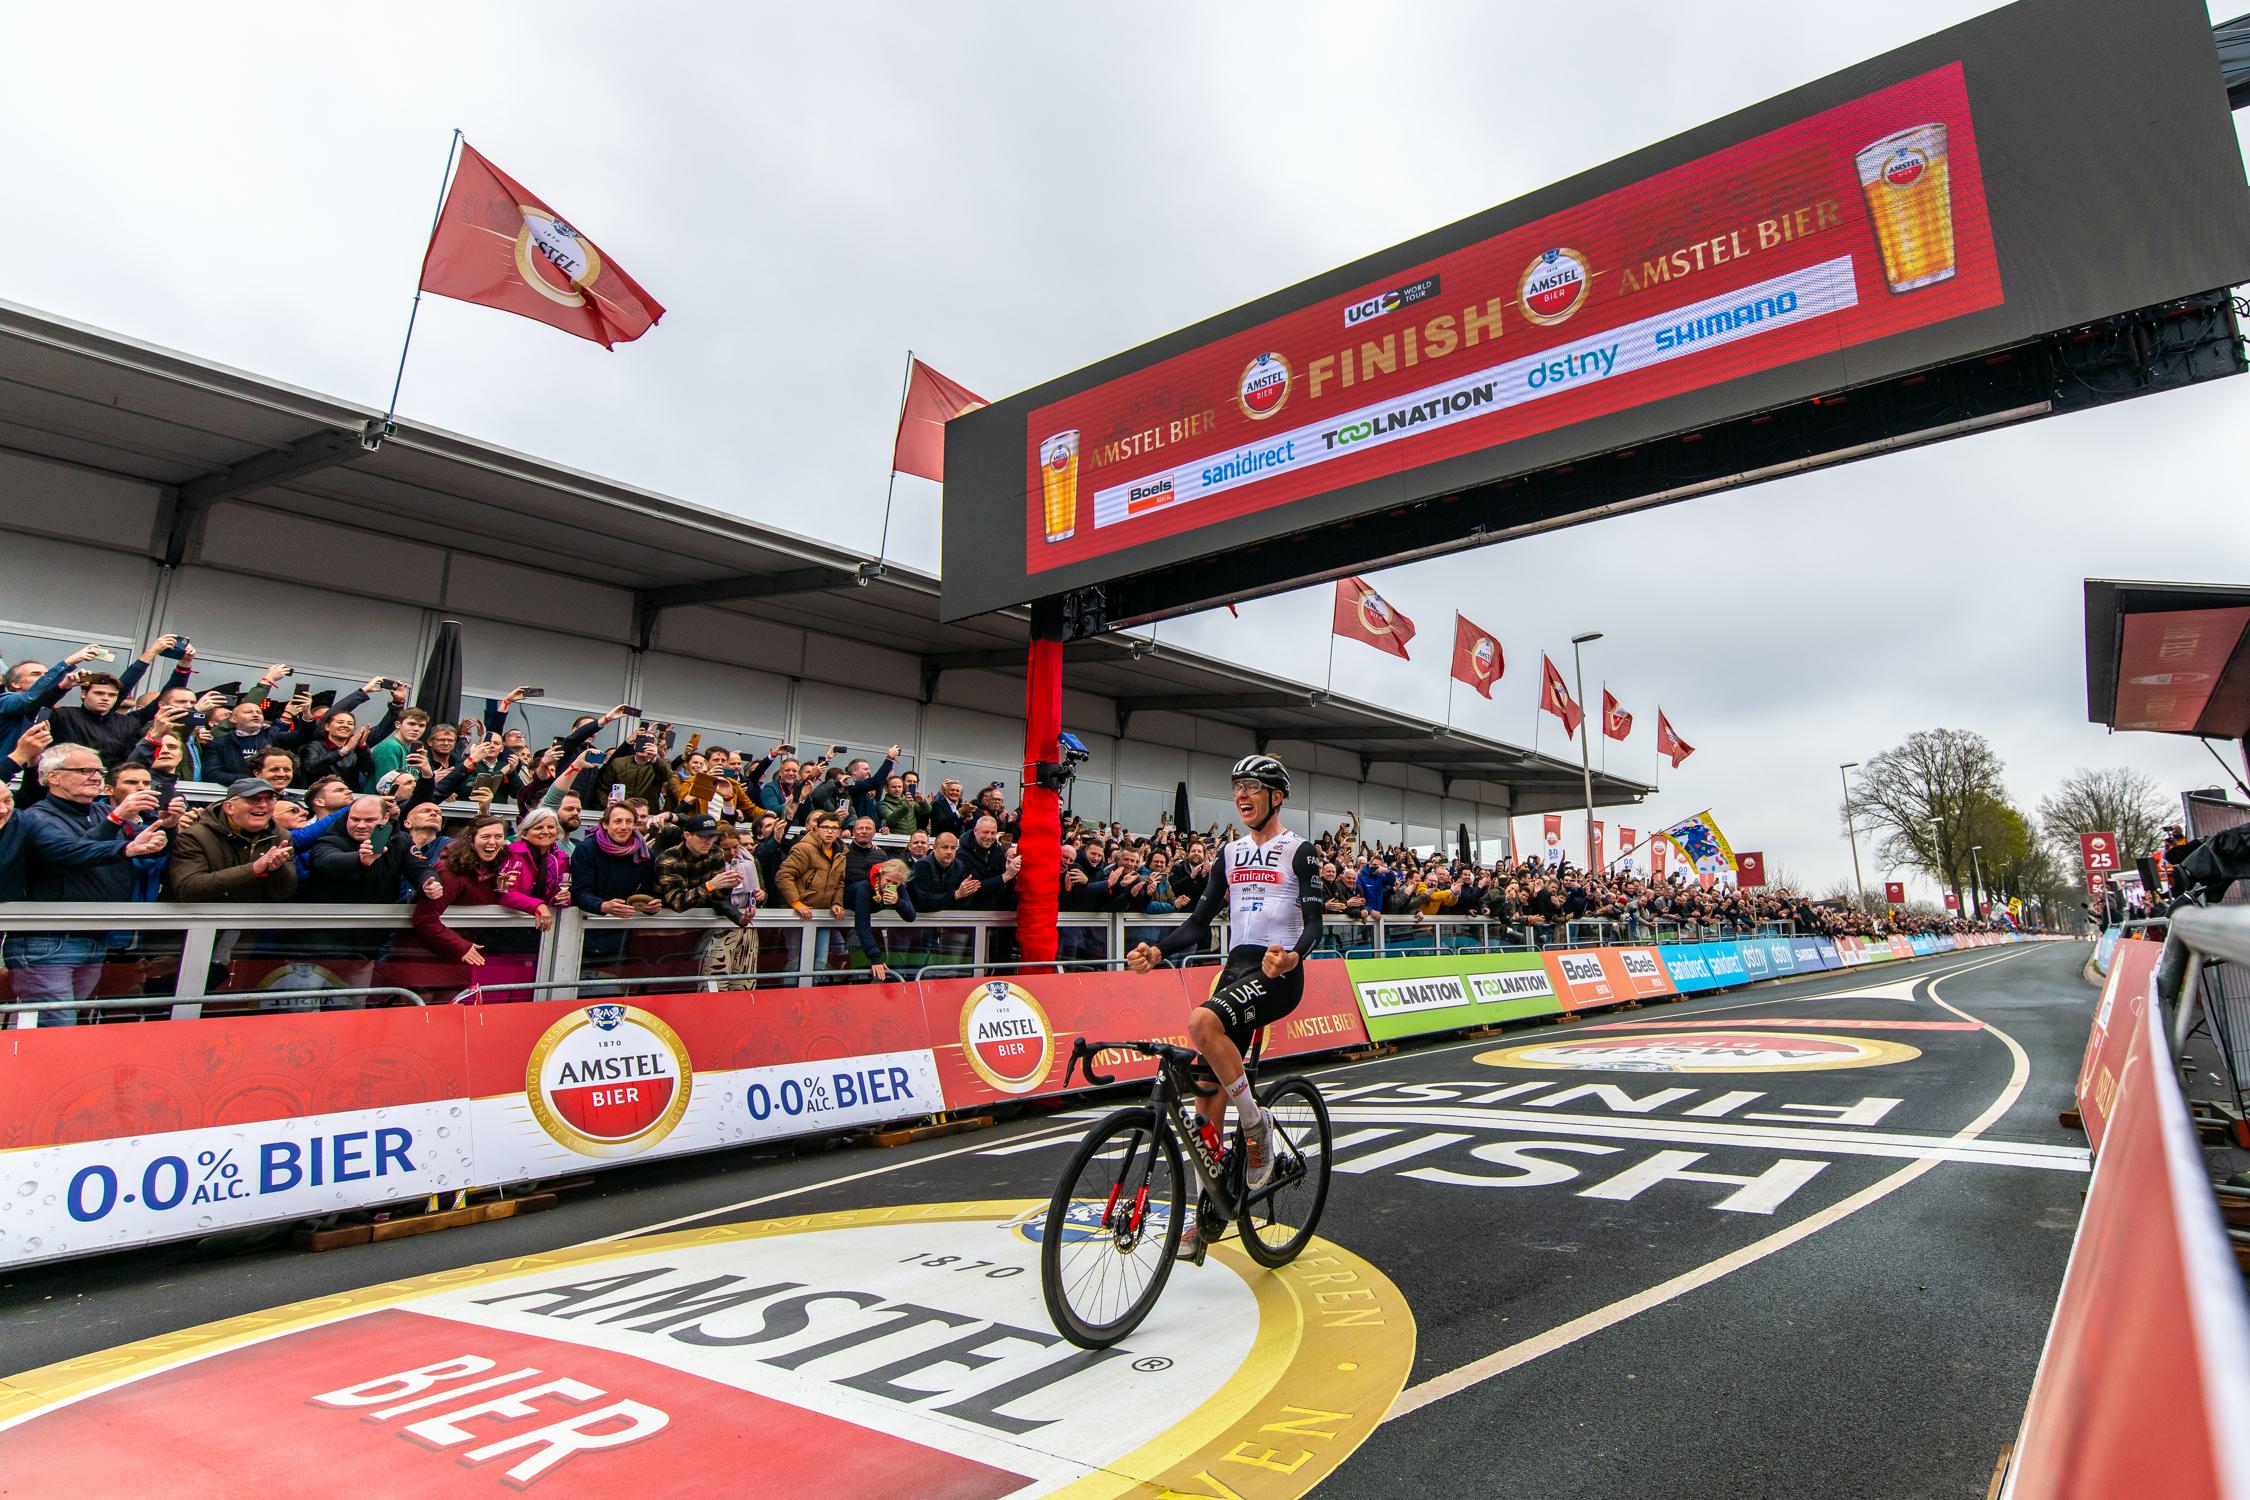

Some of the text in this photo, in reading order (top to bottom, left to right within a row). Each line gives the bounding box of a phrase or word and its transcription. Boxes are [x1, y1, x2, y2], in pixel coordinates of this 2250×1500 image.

[1889, 159, 1920, 173] AMSTEL
[535, 240, 573, 273] STEL
[1619, 199, 1841, 297] AMSTEL BIER
[1403, 281, 1432, 296] WORLD
[1530, 269, 1579, 294] AMSTEL
[1406, 290, 1426, 302] TOUR
[1544, 289, 1565, 303] BIER
[1348, 300, 1379, 322] UCI
[1654, 291, 1798, 352] SHIMANO
[1308, 296, 1503, 399] FINISH
[1527, 344, 1620, 390] dstny
[1247, 370, 1284, 392] AMSTEL
[1257, 389, 1273, 400] BIER
[1321, 384, 1495, 450] TOOLNATION
[1090, 409, 1217, 471] AMSTEL BIER
[1202, 440, 1295, 487] sanidirect
[1130, 480, 1173, 502] Boels
[1156, 495, 1172, 503] RENTAL
[1234, 848, 1282, 867] UAE
[2090, 853, 2112, 868] 25
[1233, 871, 1276, 882] Emirates
[1562, 958, 1603, 980] Boels
[1622, 955, 1657, 973] Boels
[1667, 953, 1711, 981] sanidirect
[1229, 979, 1267, 1004] UAE
[1365, 982, 1463, 1009] TOOLNATION
[1473, 975, 1548, 997] TOOLNATION
[1212, 997, 1238, 1026] mirates
[979, 1018, 1038, 1040] AMSTEL
[1286, 1012, 1359, 1040] AMSTEL BIER
[598, 1040, 622, 1048] 1870
[998, 1043, 1026, 1057] BIER
[558, 1054, 666, 1085] AMSTEL
[592, 1087, 640, 1107] BIER
[807, 1097, 835, 1114] ALC.
[833, 1066, 915, 1109] BIER
[1179, 1106, 1219, 1179] COLNAGO
[191, 1178, 251, 1206] ALC.
[259, 1126, 417, 1194] BIER
[897, 1253, 1027, 1280] 1870
[472, 1266, 1135, 1435] AMSTEL
[308, 1354, 673, 1488] BIER
